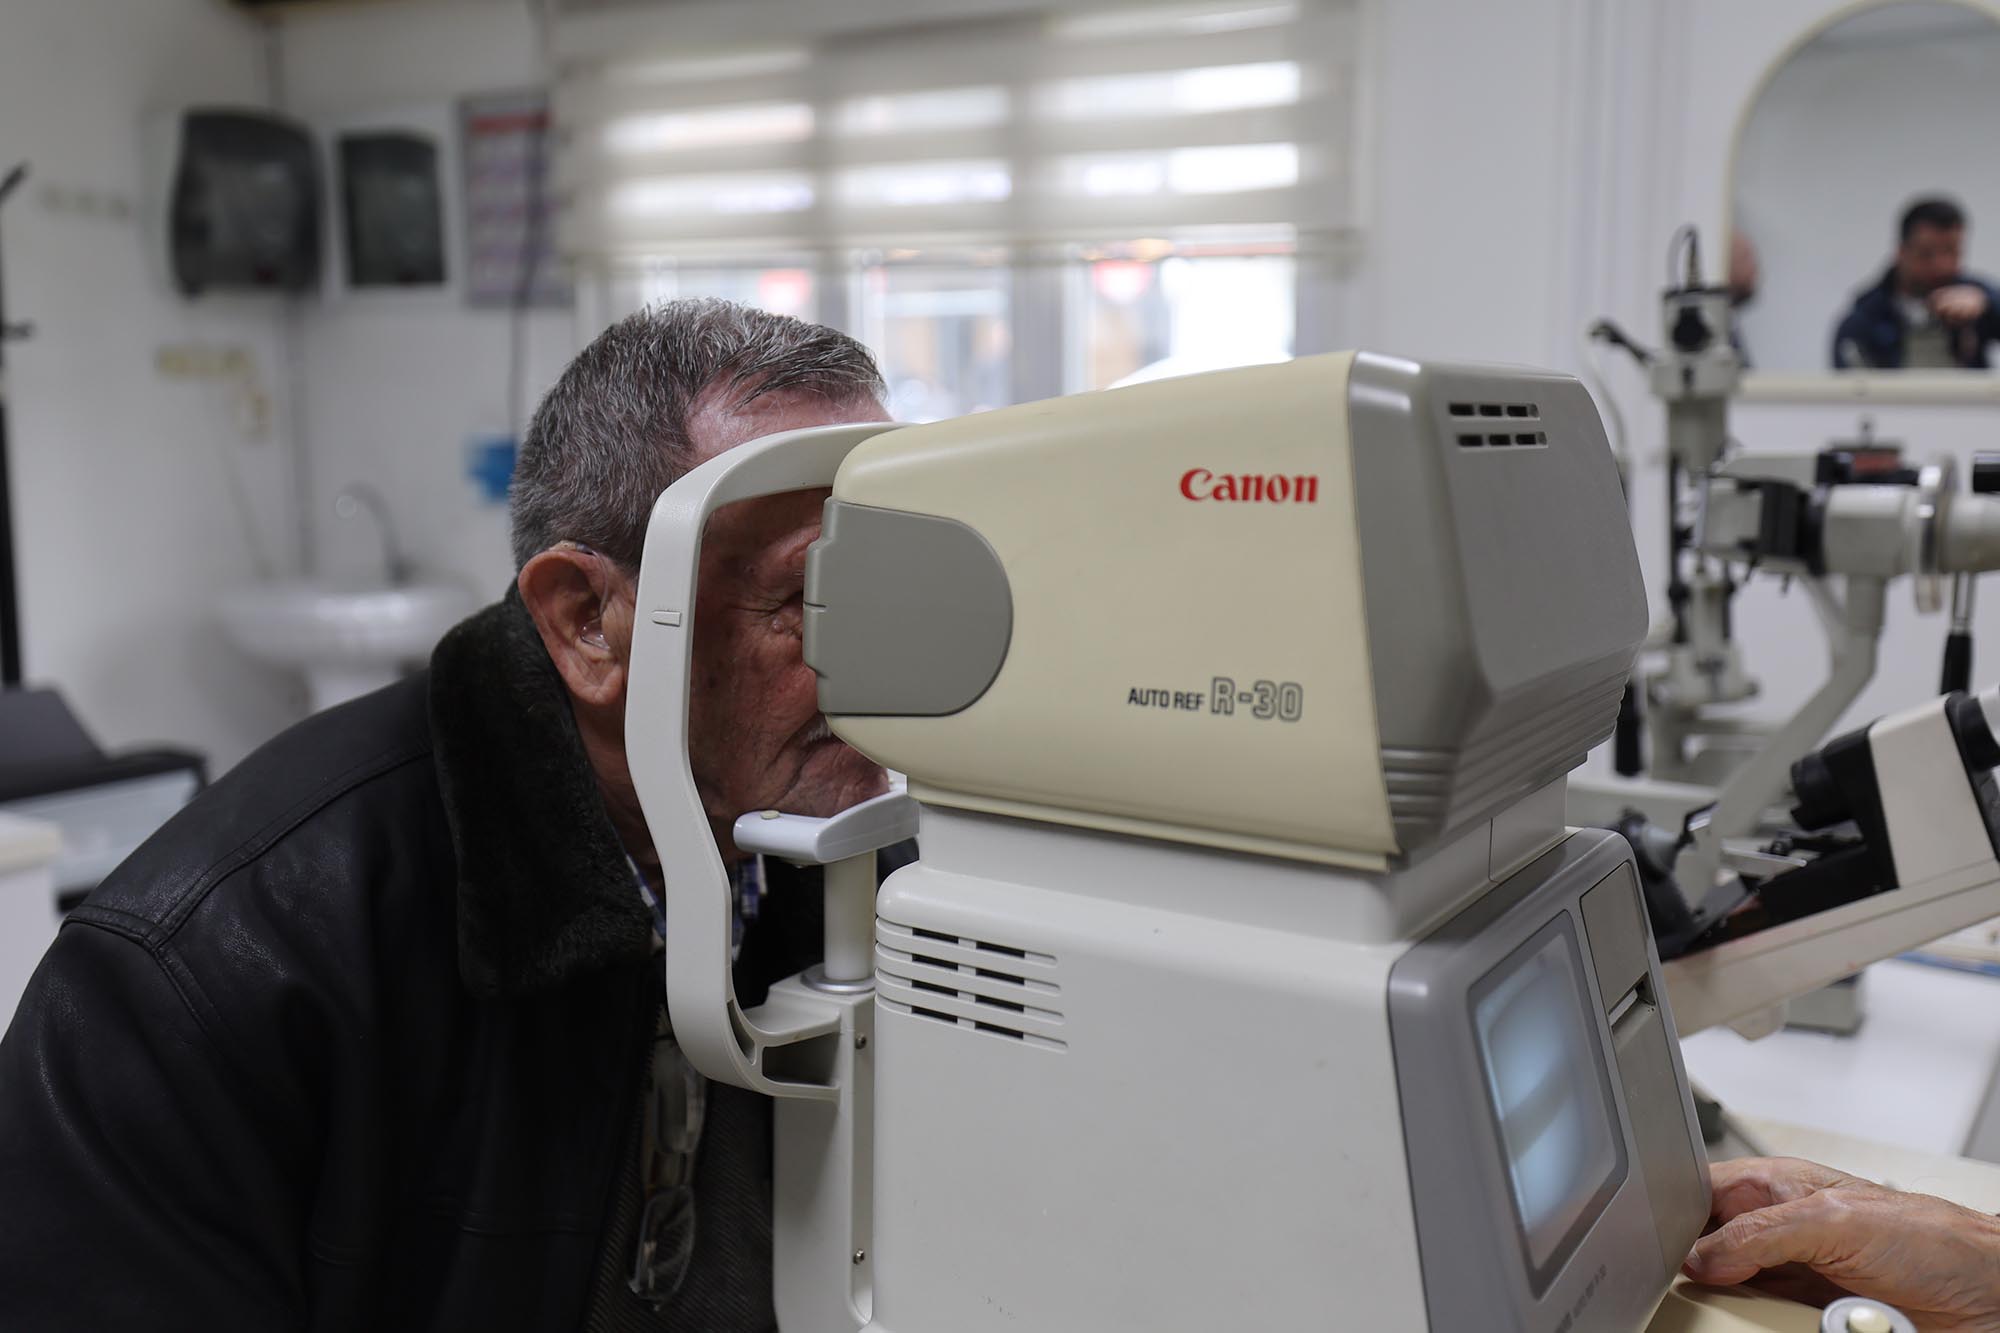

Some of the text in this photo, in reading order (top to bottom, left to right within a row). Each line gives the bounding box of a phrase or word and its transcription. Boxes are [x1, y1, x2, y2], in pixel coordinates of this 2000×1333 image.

[1179, 467, 1319, 503] Canon
[1127, 676, 1303, 722] AUTO REF R-30
